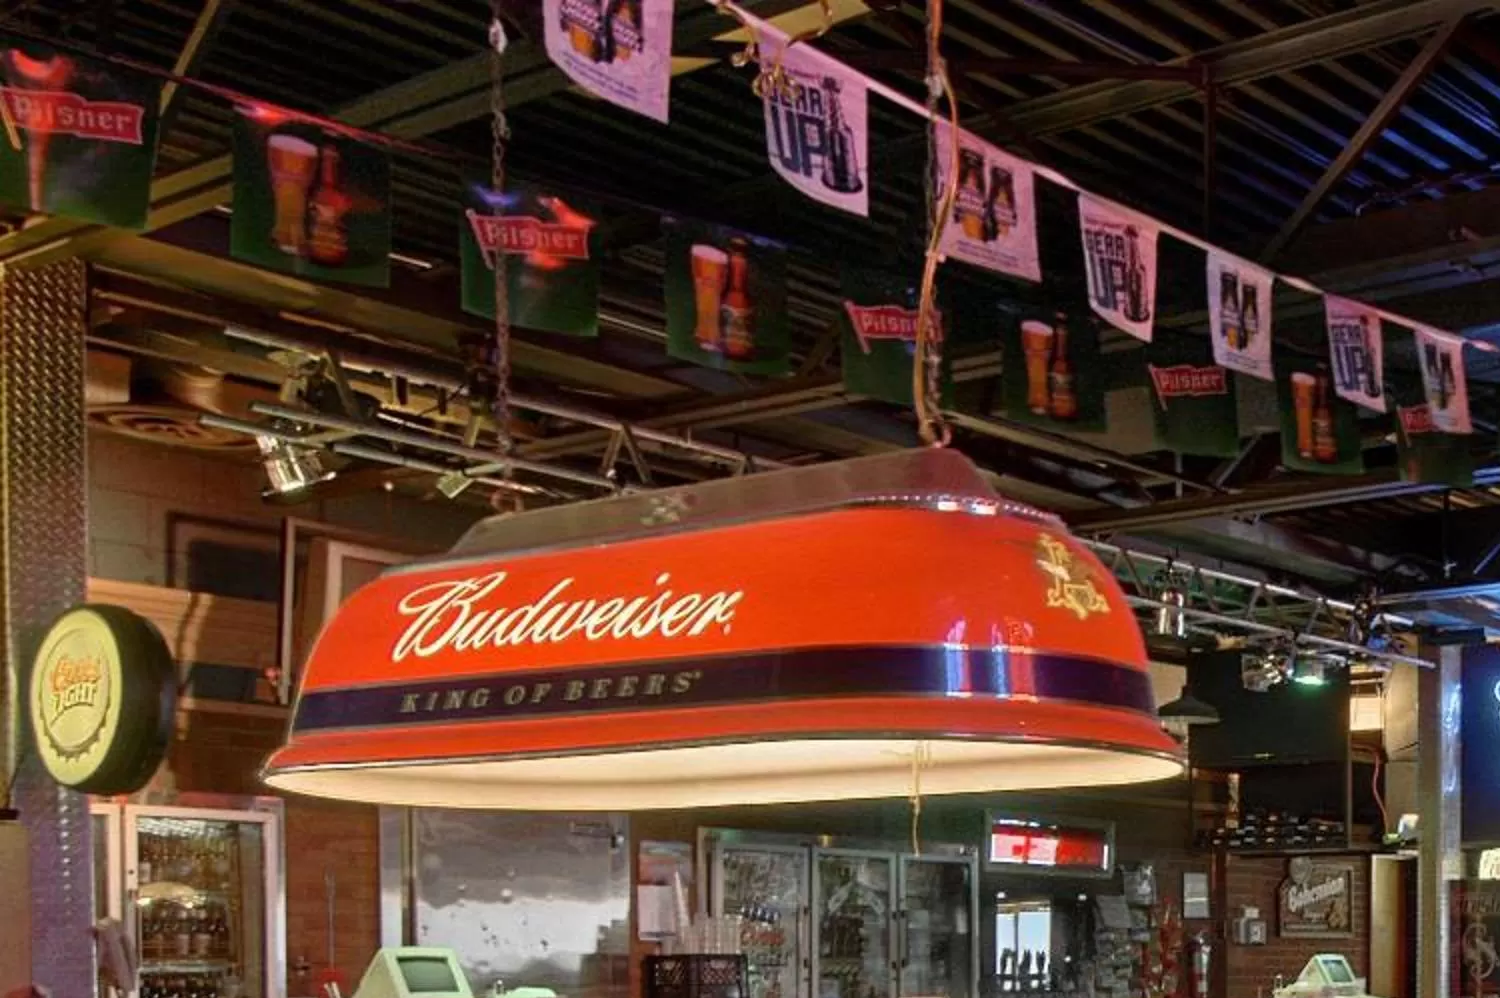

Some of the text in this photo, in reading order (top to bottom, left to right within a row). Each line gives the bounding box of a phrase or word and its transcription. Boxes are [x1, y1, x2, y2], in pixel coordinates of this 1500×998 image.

[770, 105, 830, 178] UP
[392, 571, 743, 663] Budweiser
[400, 671, 695, 714] KING OF BEERS
